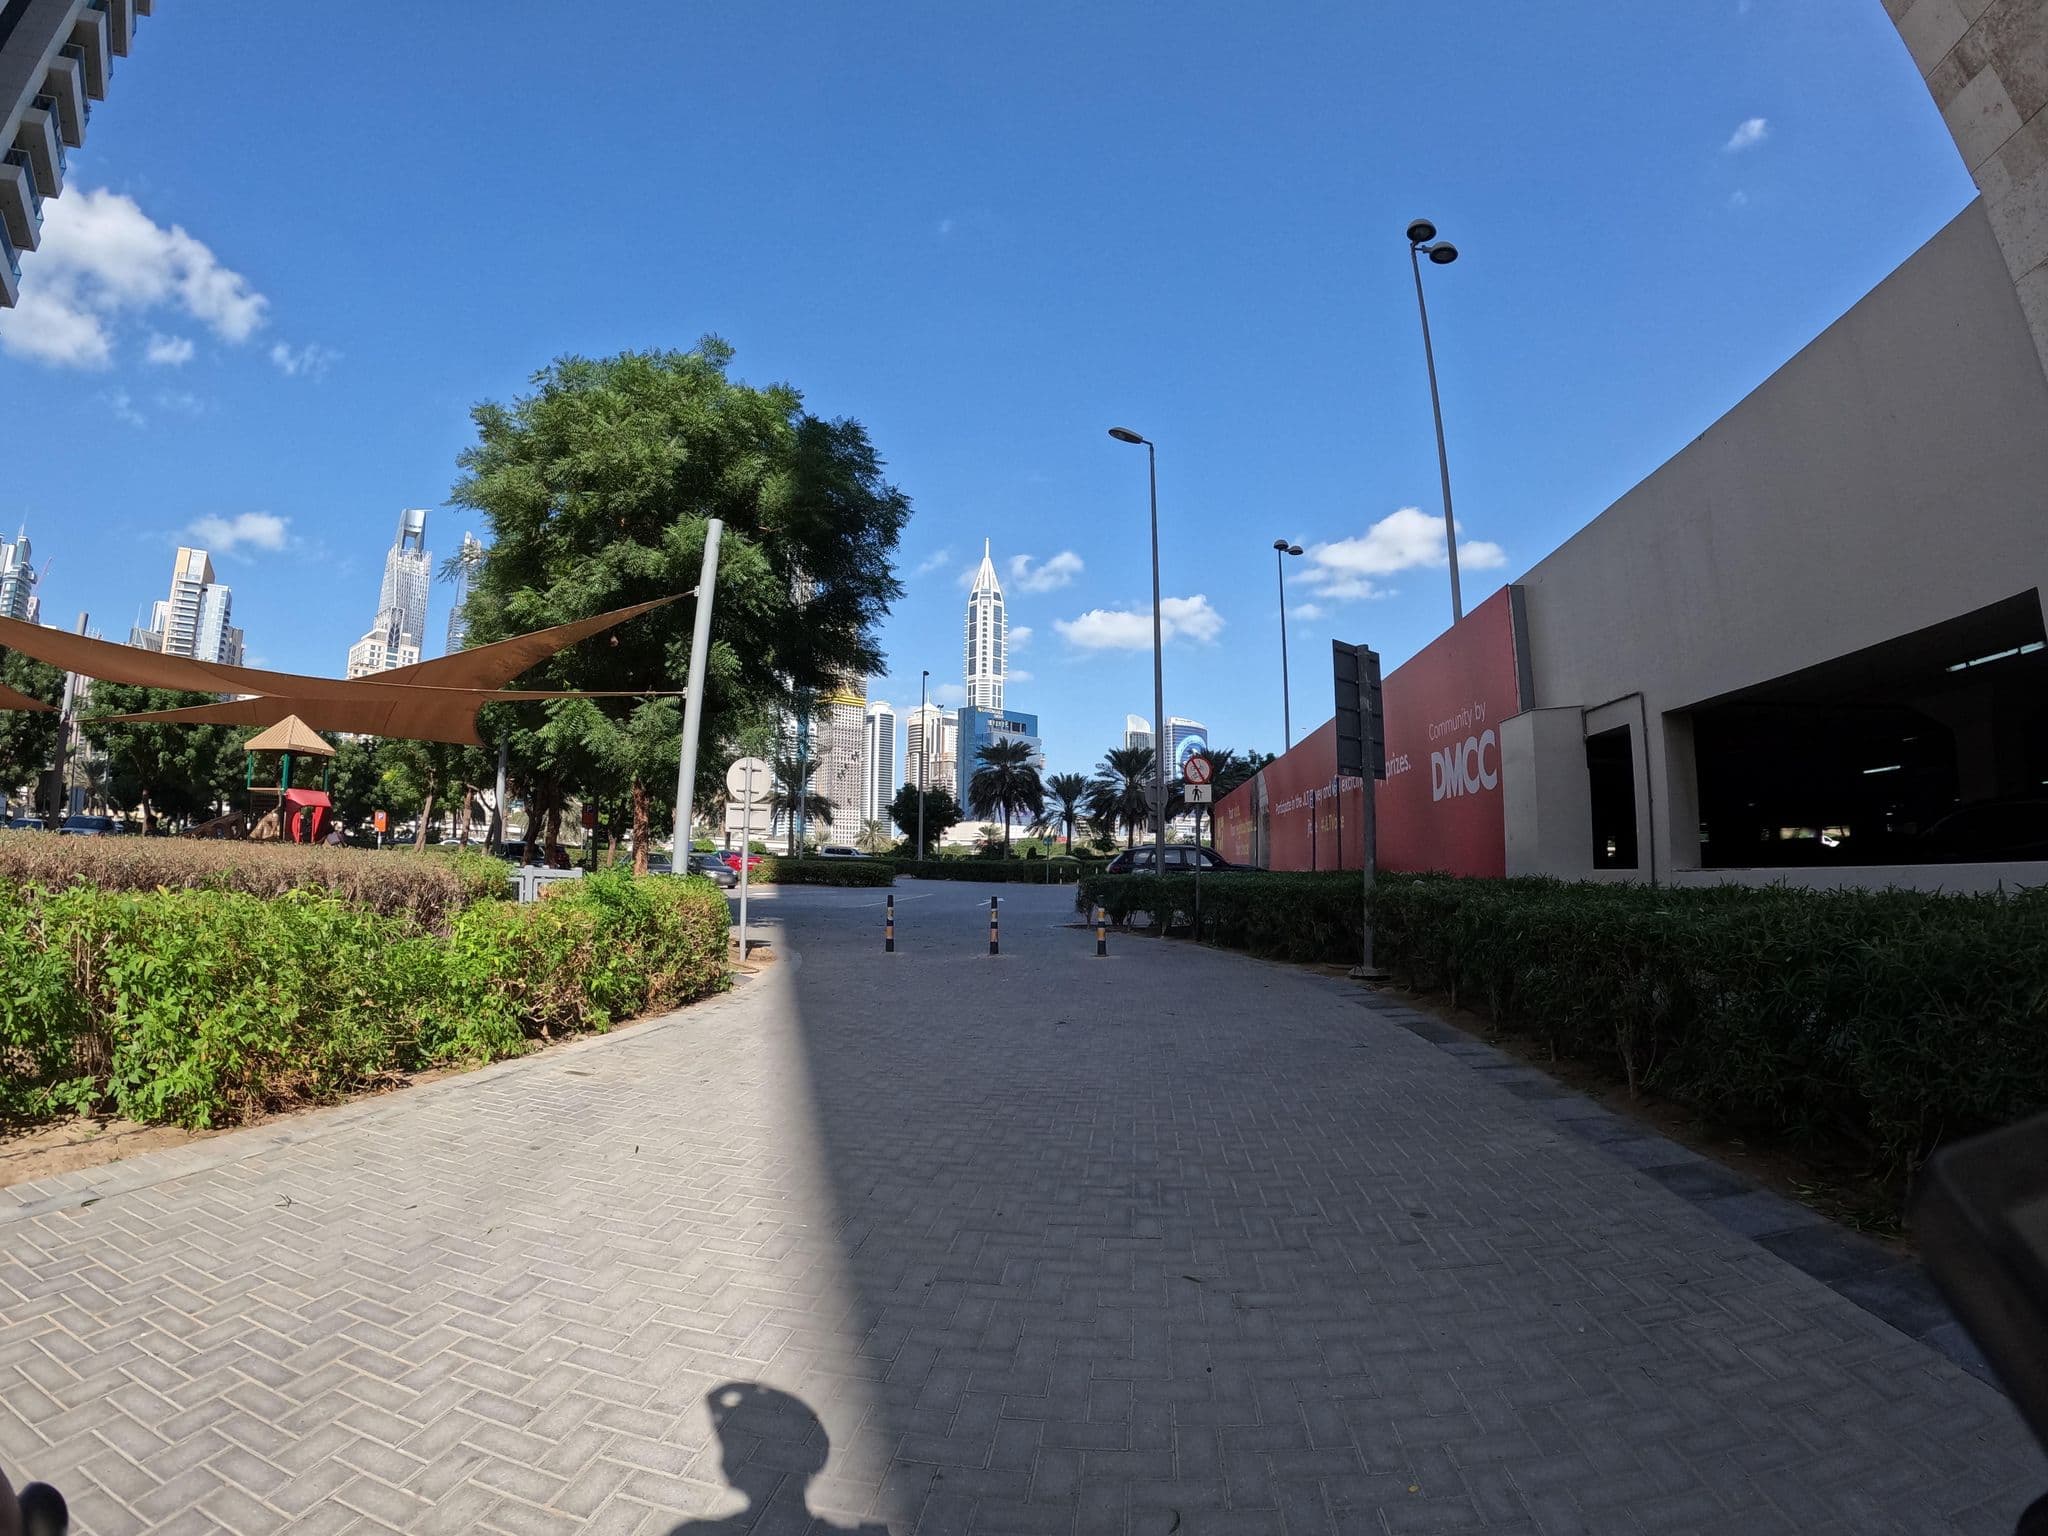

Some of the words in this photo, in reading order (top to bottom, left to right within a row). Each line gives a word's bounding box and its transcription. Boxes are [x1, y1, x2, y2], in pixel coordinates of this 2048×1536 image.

[1428, 708, 1473, 741] Community
[1474, 701, 1486, 722] by
[1385, 752, 1412, 785] prizes.
[1431, 729, 1498, 802] DMCC
